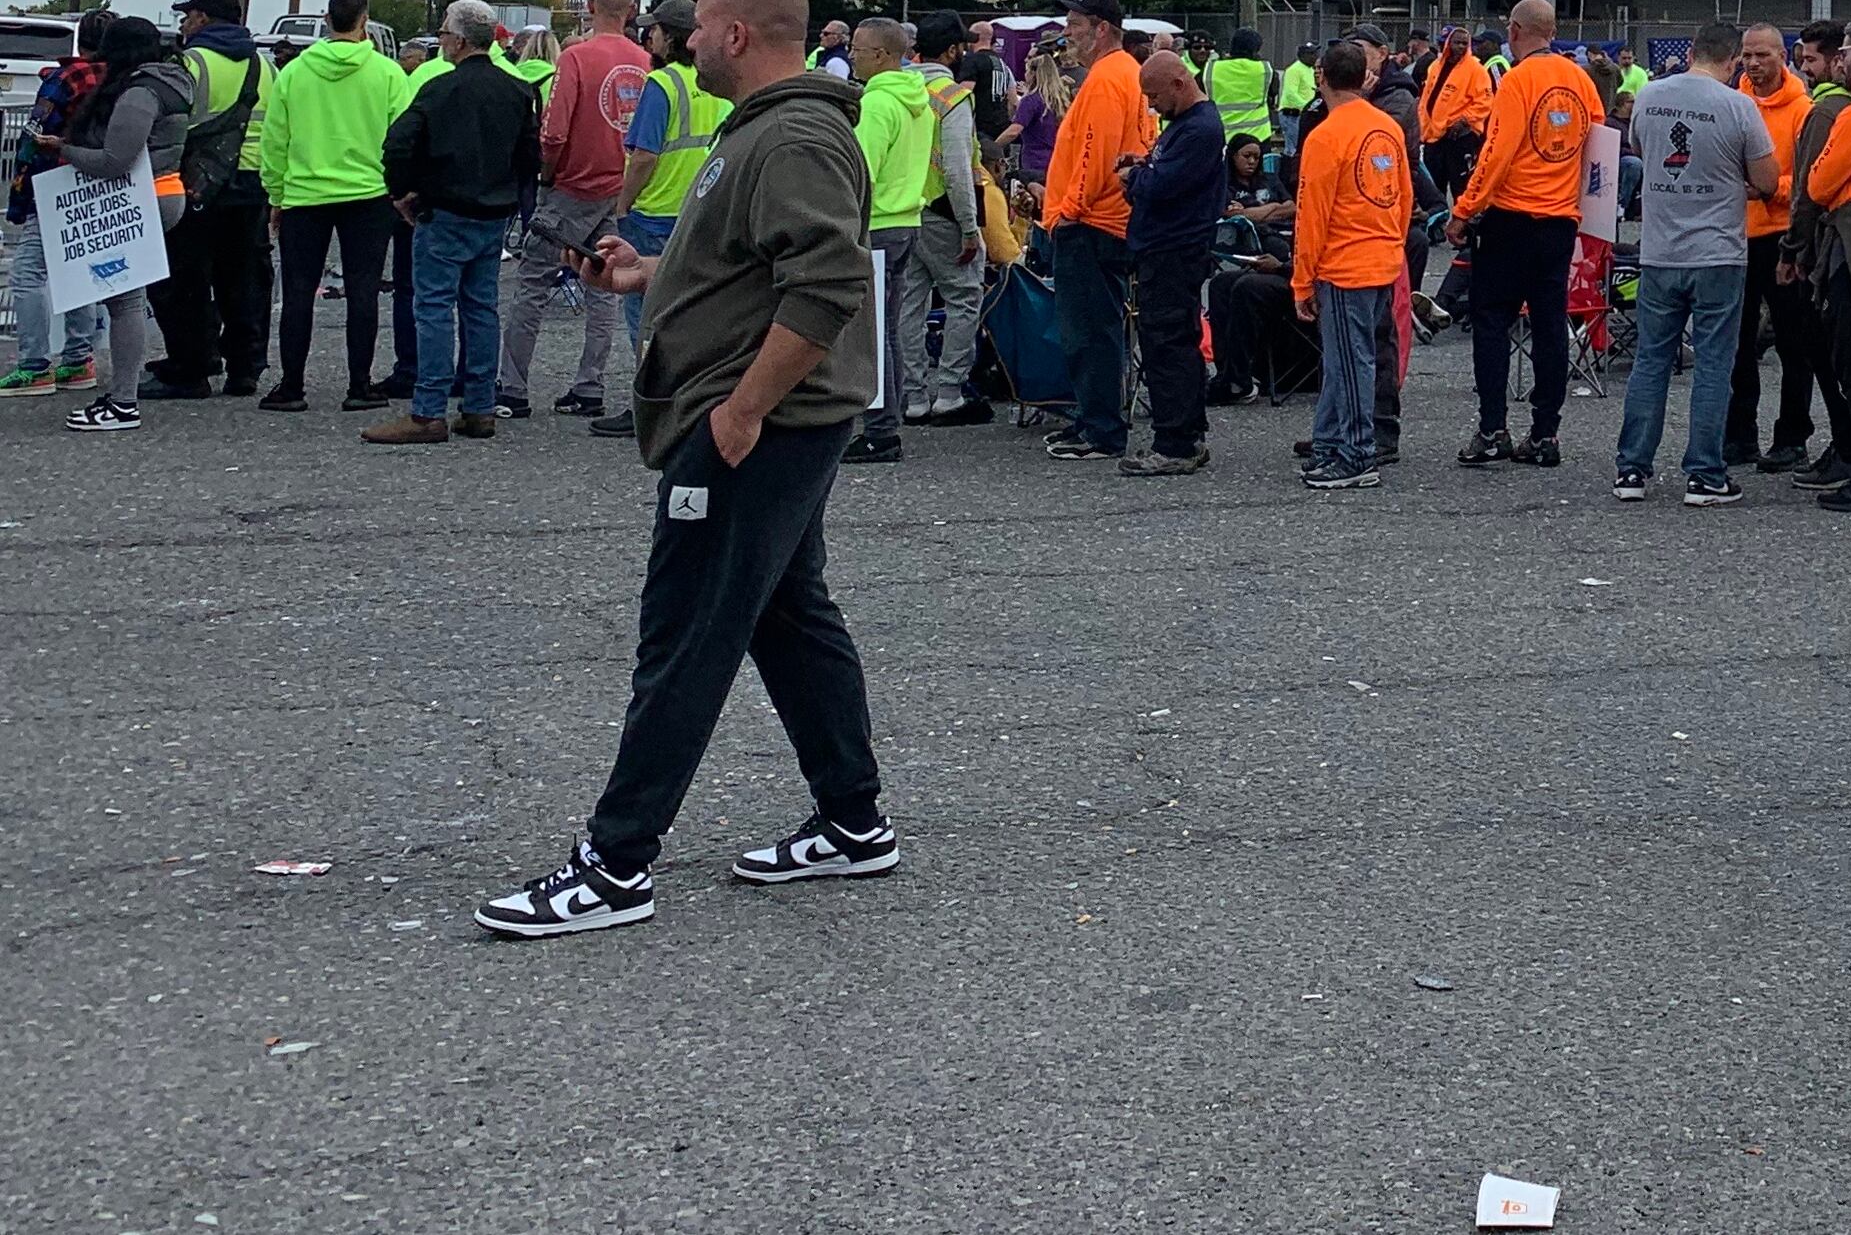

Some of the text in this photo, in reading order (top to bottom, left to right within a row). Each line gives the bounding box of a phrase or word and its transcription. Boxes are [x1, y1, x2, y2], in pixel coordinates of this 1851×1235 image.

[1645, 107, 1716, 124] KEARNY FMBA
[1083, 123, 1093, 168] LOCAL
[1485, 118, 1499, 162] LOCAL
[74, 170, 102, 187] FIG
[1649, 182, 1680, 194] LOCAL
[60, 205, 143, 245] ILA DEMANDS
[65, 192, 132, 225] SAVE JOBS:
[63, 222, 145, 263] JOB SECURITY
